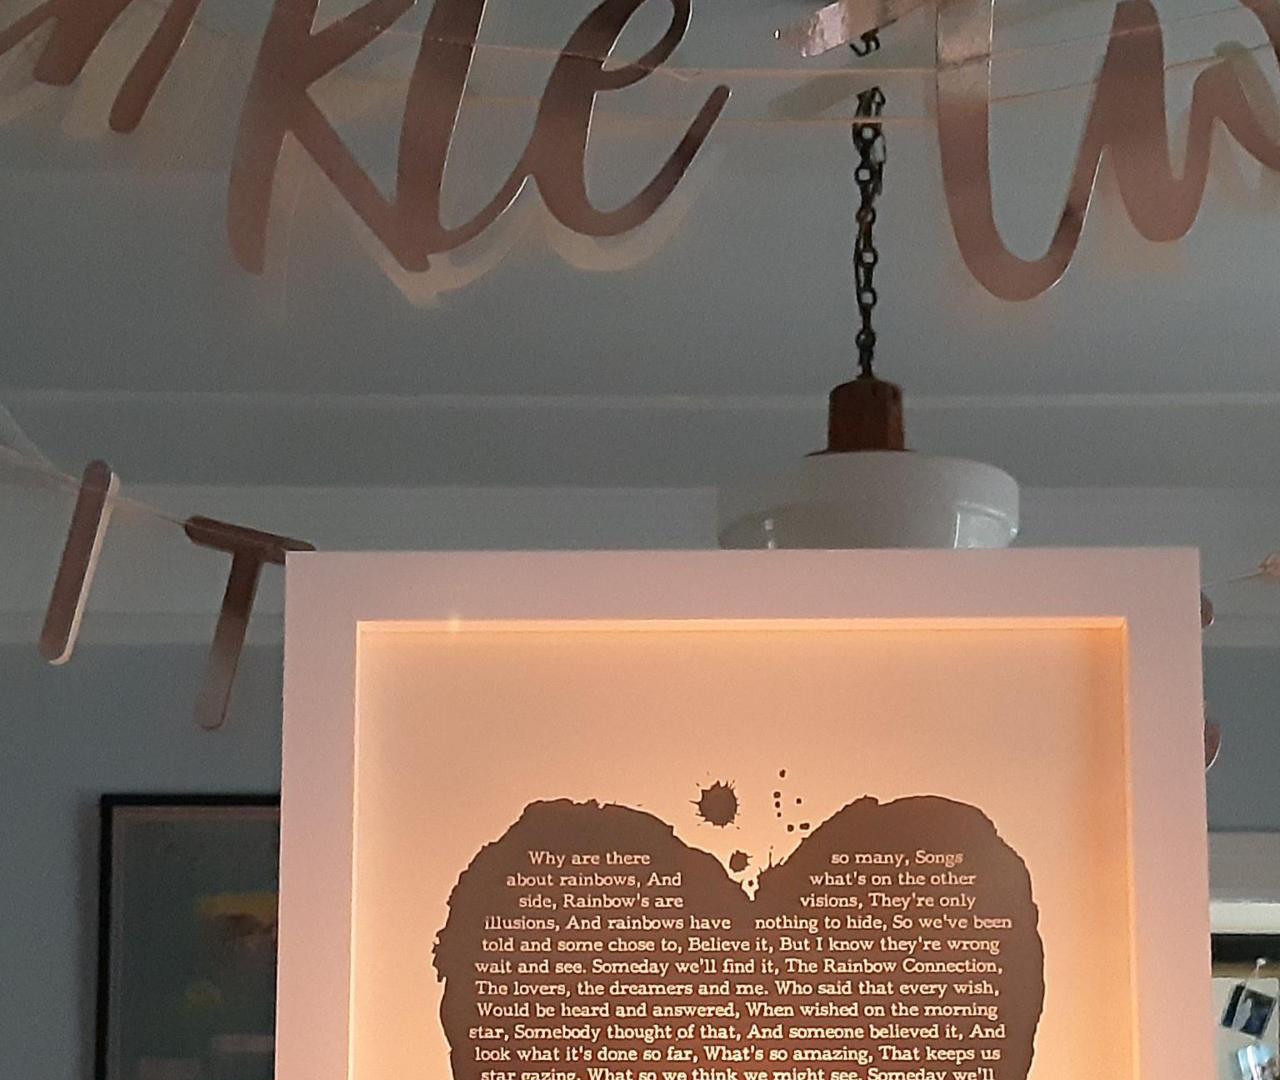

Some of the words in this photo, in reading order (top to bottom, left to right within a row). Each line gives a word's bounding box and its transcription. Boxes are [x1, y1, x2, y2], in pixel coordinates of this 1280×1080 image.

[528, 850, 566, 869] Why
[571, 853, 601, 865] are
[605, 850, 651, 865] there
[831, 853, 850, 865] so
[854, 853, 910, 869] many,
[914, 850, 963, 869] Songs
[506, 871, 554, 886] about
[559, 871, 641, 889] rainbows,
[646, 871, 682, 886] And
[809, 871, 867, 886] what's
[871, 874, 893, 886] on
[897, 871, 926, 886] the
[930, 871, 977, 886] other
[518, 893, 557, 911] side,
[562, 893, 650, 908] Rainbow's
[654, 896, 684, 908] are
[799, 893, 864, 911] visions,
[867, 893, 935, 912] They're
[939, 893, 976, 912] only
[484, 915, 560, 933] illusions,
[564, 915, 602, 930] And
[606, 915, 685, 930] rainbows
[689, 915, 732, 930] have
[755, 915, 819, 934] nothing
[823, 916, 842, 930] to
[846, 915, 888, 933] hide,
[892, 915, 914, 930] So
[918, 915, 968, 930] we've
[973, 915, 1012, 930] been
[482, 937, 515, 952] told
[519, 937, 552, 952] and
[557, 940, 604, 952] some
[607, 937, 656, 952] chose
[660, 938, 683, 955] to,
[687, 937, 751, 952] Believe
[755, 937, 774, 955] it,
[778, 937, 811, 952] But
[815, 937, 824, 952] I
[828, 937, 875, 952] know
[879, 937, 942, 956] they're
[946, 940, 1000, 956] wrong
[474, 959, 513, 974] wait
[517, 959, 550, 974] and
[554, 962, 587, 974] see.
[591, 959, 670, 978] Someday
[674, 959, 717, 974] we'll
[721, 959, 755, 974] find
[761, 959, 780, 977] it,
[784, 959, 819, 974] The
[823, 959, 898, 974] Rainbow
[902, 959, 1003, 977] Connection,
[474, 980, 509, 995] The
[512, 980, 571, 998] lovers,
[577, 980, 605, 995] the
[609, 980, 694, 995] dreamers
[697, 980, 731, 995] and
[735, 983, 769, 995] me.
[774, 980, 813, 995] Who
[817, 980, 853, 995] said
[858, 980, 895, 995] that
[899, 983, 948, 999] every
[952, 980, 1000, 998] wish,
[476, 1002, 530, 1017] Would
[535, 1002, 556, 1017] be
[560, 1002, 610, 1017] heard
[615, 1002, 648, 1017] and
[652, 1002, 740, 1020] answered,
[744, 1002, 795, 1017] When
[799, 1002, 860, 1017] wished
[863, 1005, 886, 1017] on
[890, 1002, 920, 1017] the
[923, 1002, 999, 1021] morning
[468, 1025, 510, 1042] star,
[513, 1024, 602, 1043] Somebody
[606, 1024, 673, 1043] thought
[675, 1024, 696, 1039] of
[699, 1024, 742, 1042] that,
[746, 1024, 784, 1039] And
[788, 1027, 865, 1039] someone
[868, 1024, 940, 1039] believed
[944, 1024, 964, 1042] it,
[968, 1024, 1006, 1039] And
